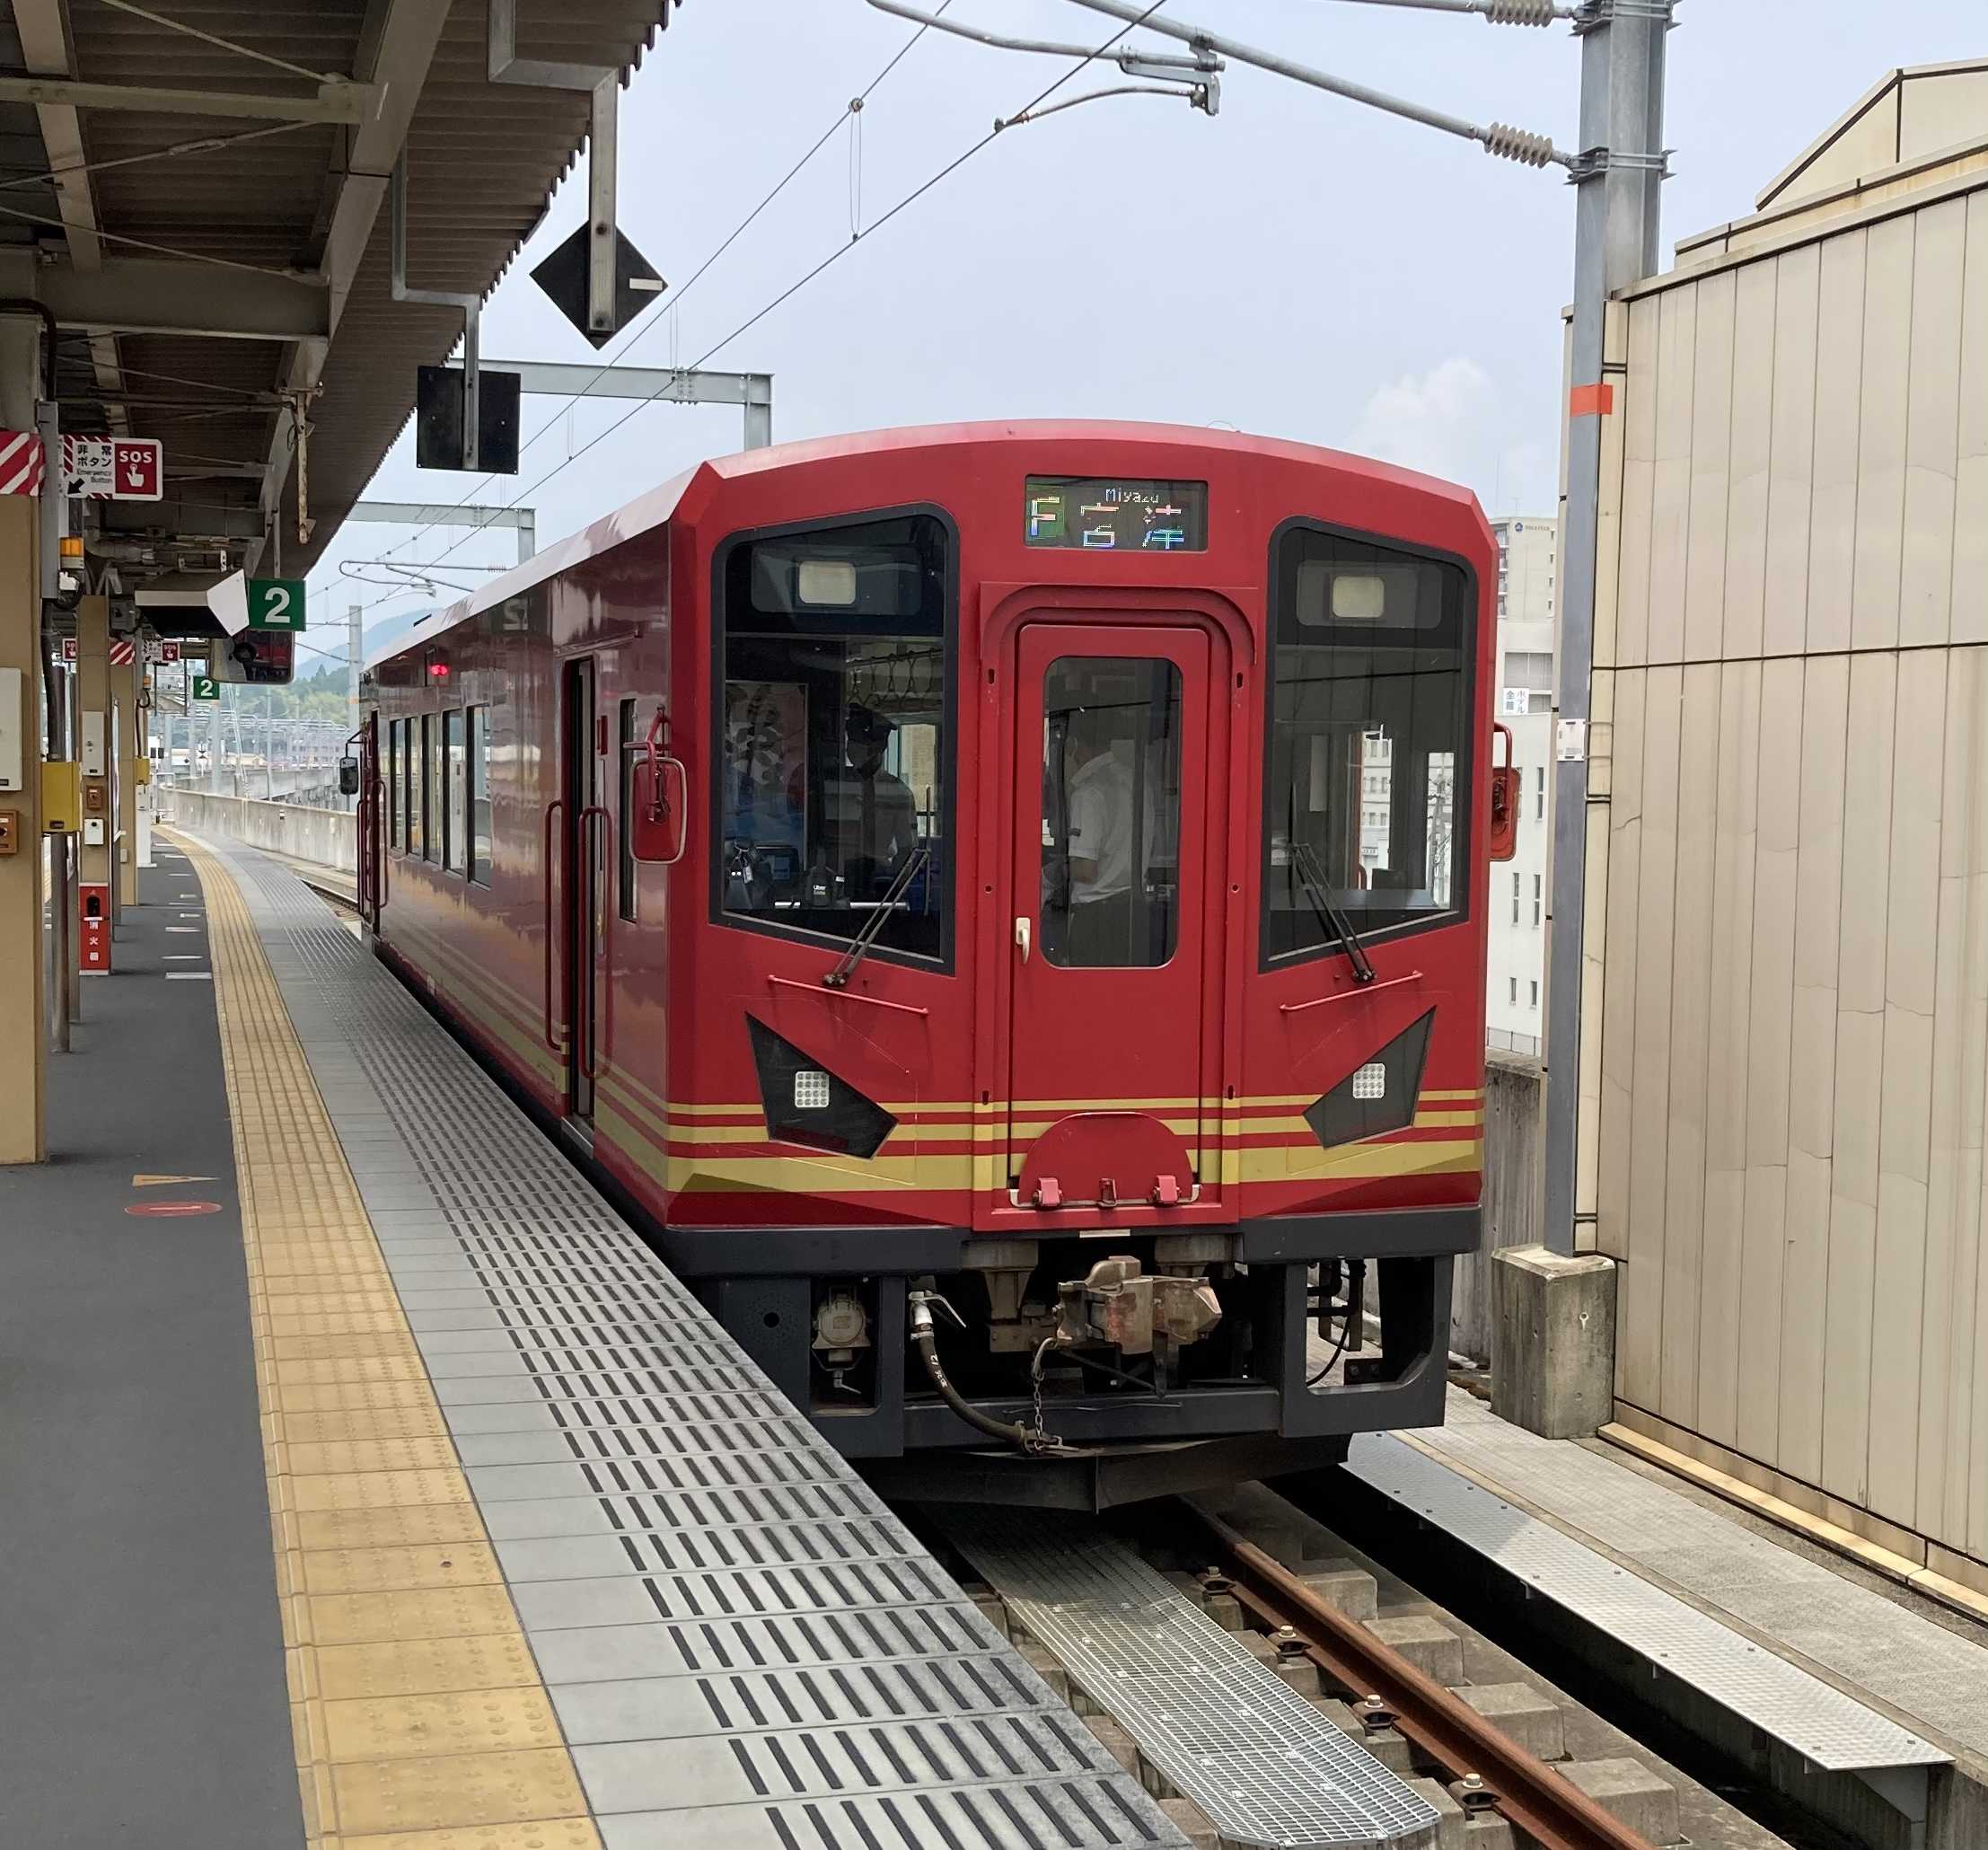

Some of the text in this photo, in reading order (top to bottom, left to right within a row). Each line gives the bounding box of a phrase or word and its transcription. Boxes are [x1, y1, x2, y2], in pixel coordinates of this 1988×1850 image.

[78, 457, 112, 467] ボタン
[119, 450, 153, 463] SOS
[1031, 497, 1060, 535] F
[265, 586, 290, 623] 2
[200, 679, 213, 696] 2
